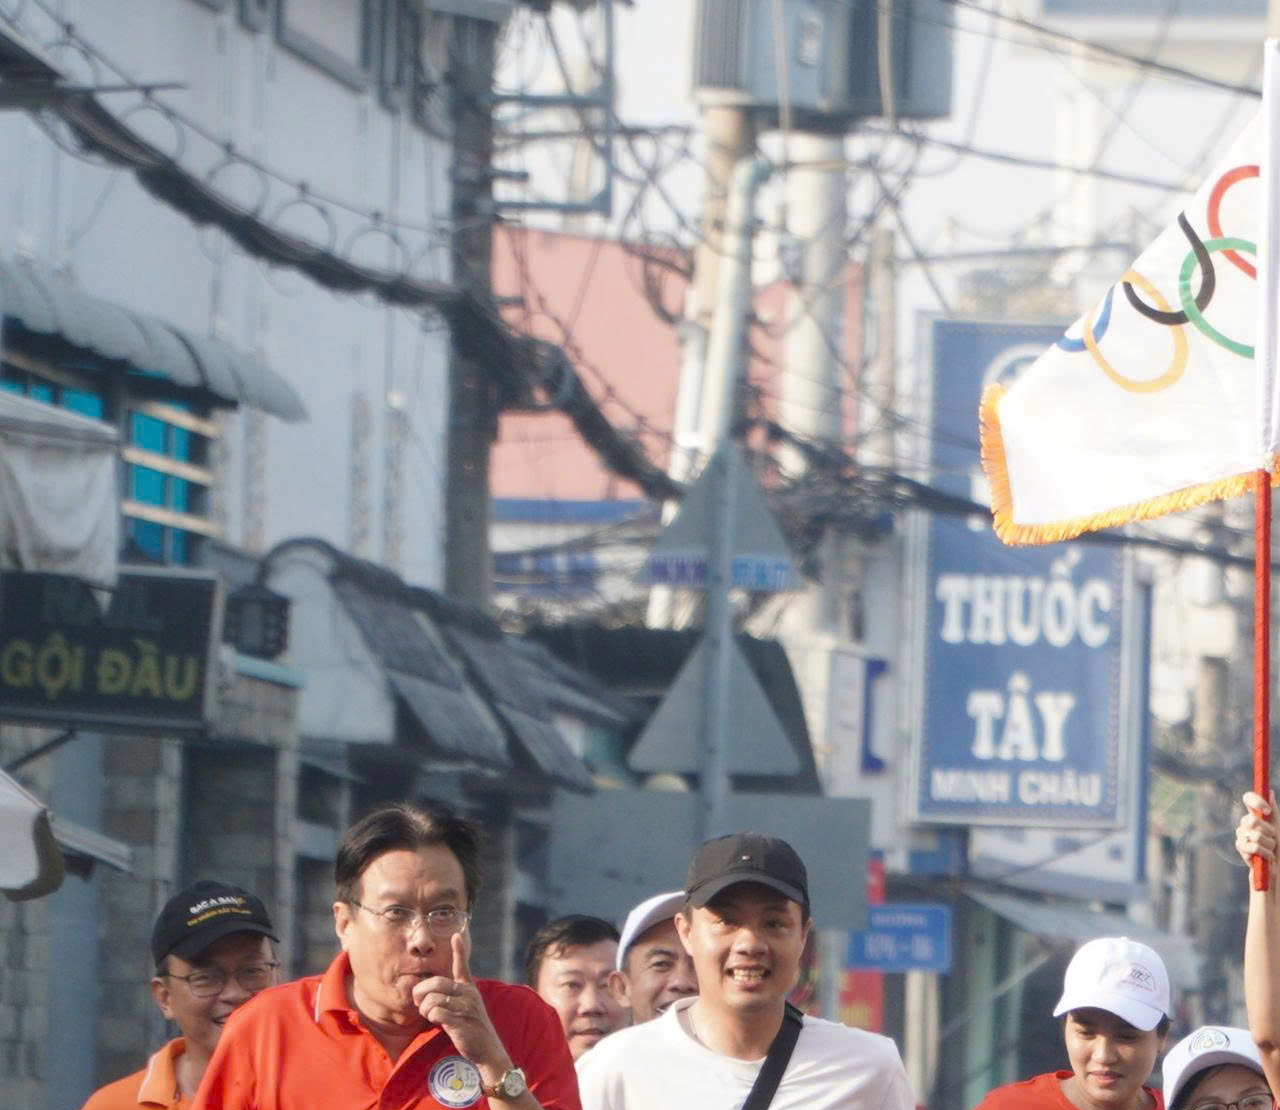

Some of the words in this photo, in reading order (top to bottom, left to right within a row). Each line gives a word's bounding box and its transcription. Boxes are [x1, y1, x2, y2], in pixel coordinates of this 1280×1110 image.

[936, 546, 1113, 649] THUỐC
[2, 633, 84, 701] GỘI
[97, 637, 200, 702] ĐẦU
[966, 671, 1076, 762] TÂY
